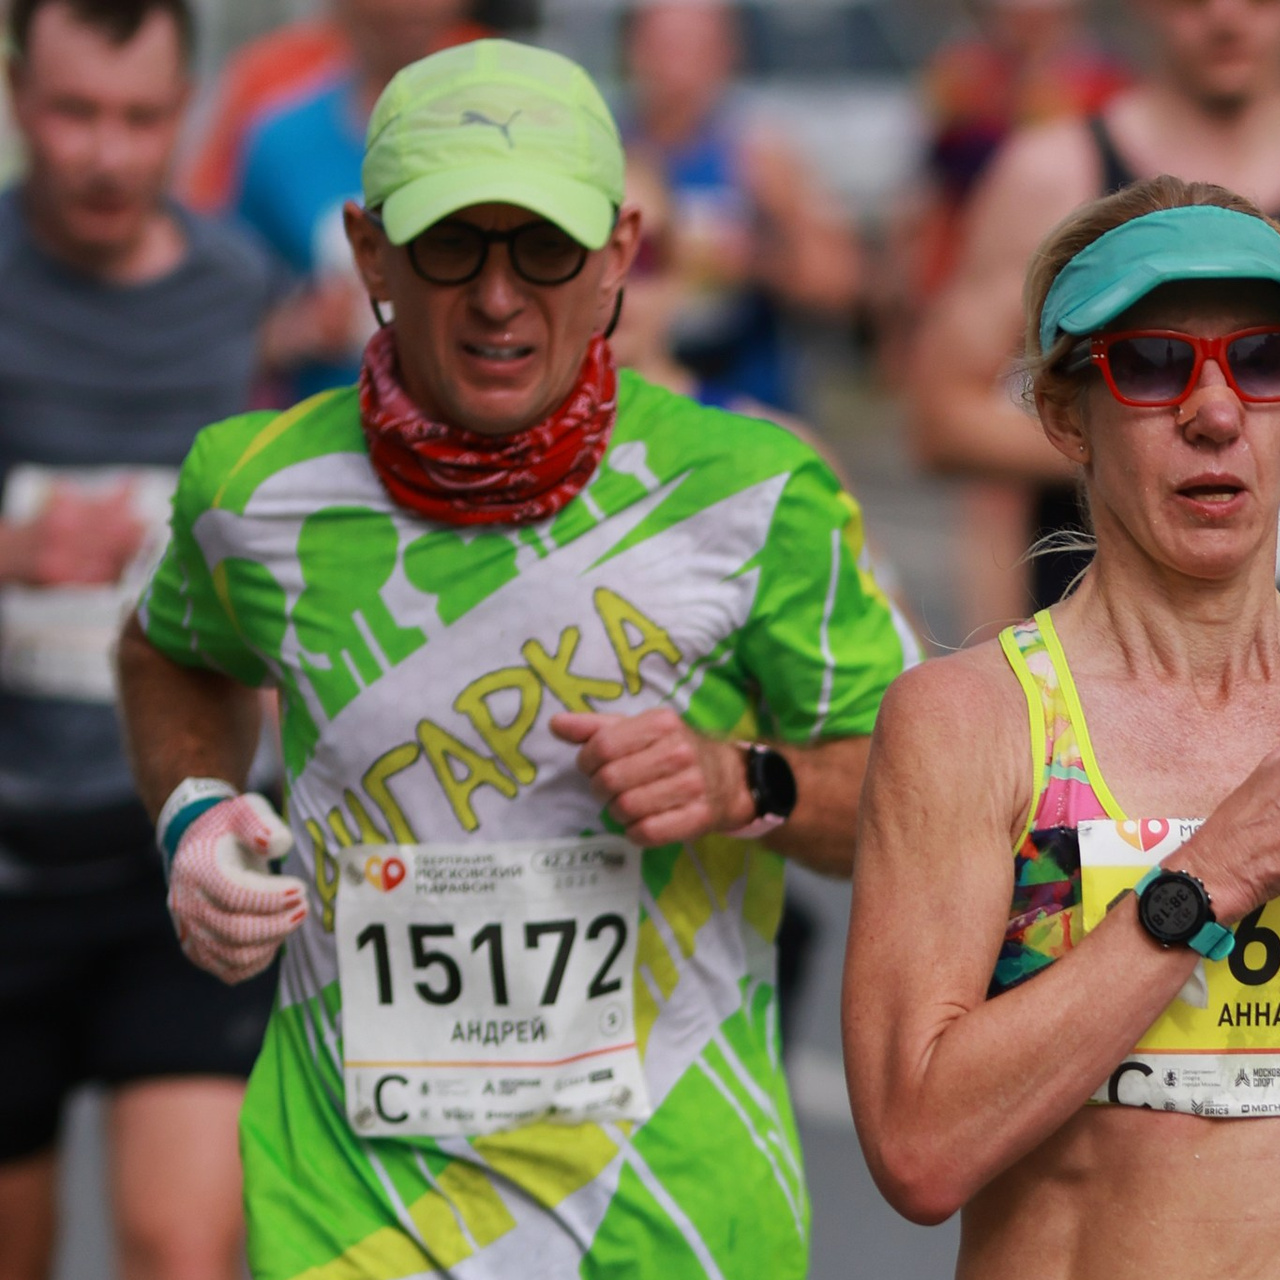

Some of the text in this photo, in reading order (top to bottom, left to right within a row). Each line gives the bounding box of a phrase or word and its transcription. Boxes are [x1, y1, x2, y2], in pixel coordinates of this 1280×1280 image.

[415, 864, 523, 879] МОСКОВСКИЙ
[415, 882, 495, 894] МАРАФОН
[356, 914, 627, 1007] 15172
[451, 1016, 547, 1047] АНДРЕЙ
[1253, 1077, 1275, 1088] СПОРТ
[1204, 1107, 1229, 1115] BRICS
